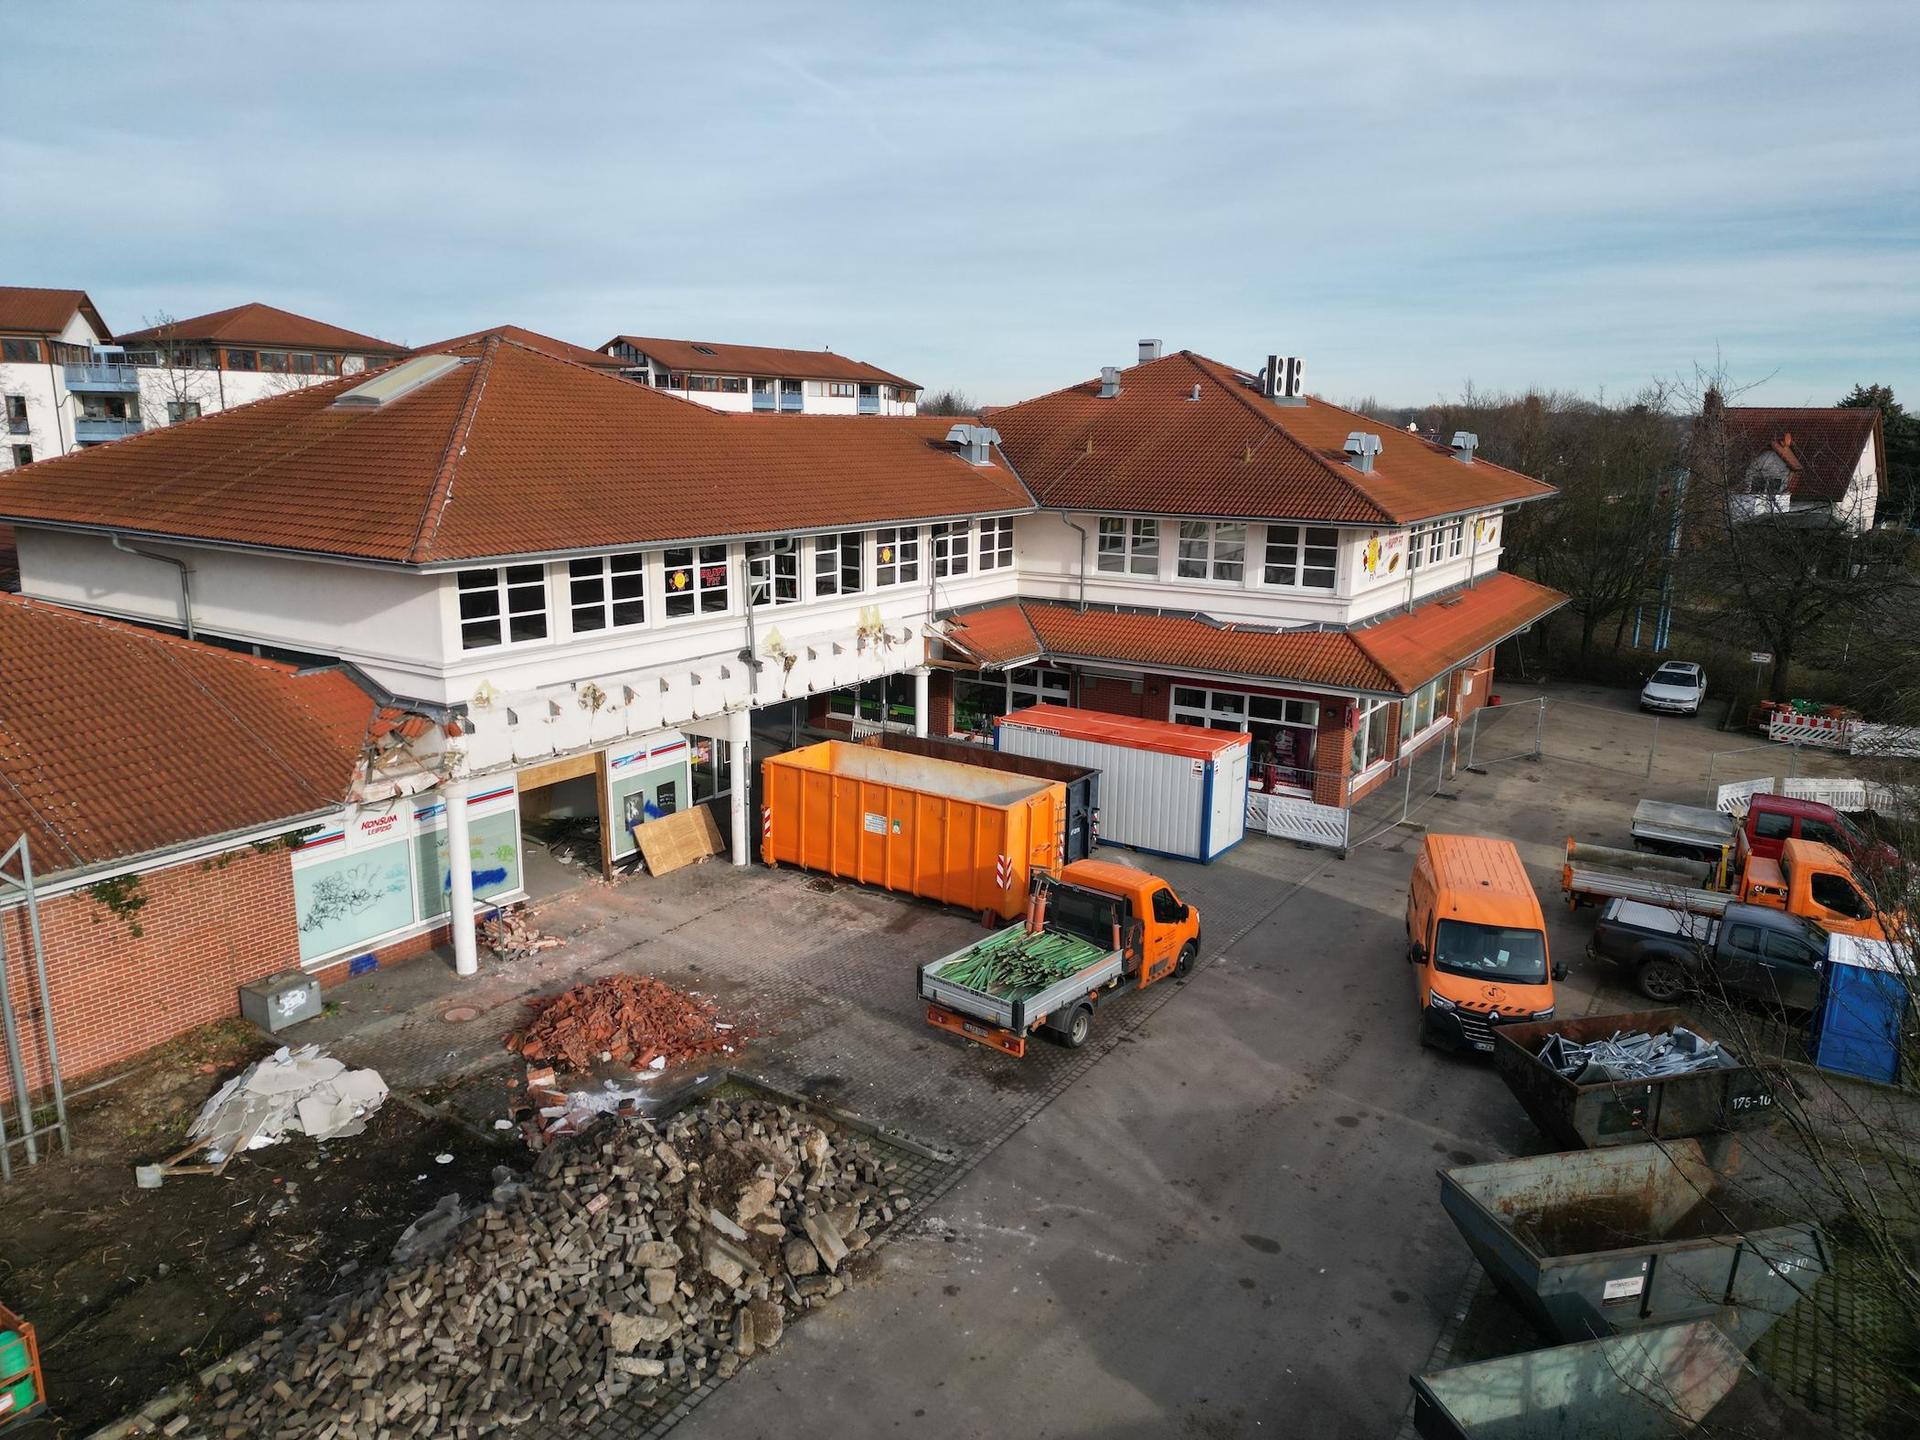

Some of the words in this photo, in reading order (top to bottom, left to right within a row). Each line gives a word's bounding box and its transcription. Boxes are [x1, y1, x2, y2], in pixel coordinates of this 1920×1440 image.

[361, 814, 398, 830] KONSUM
[368, 823, 393, 836] LEIPZIG
[1732, 1094, 1771, 1110] 175-10
